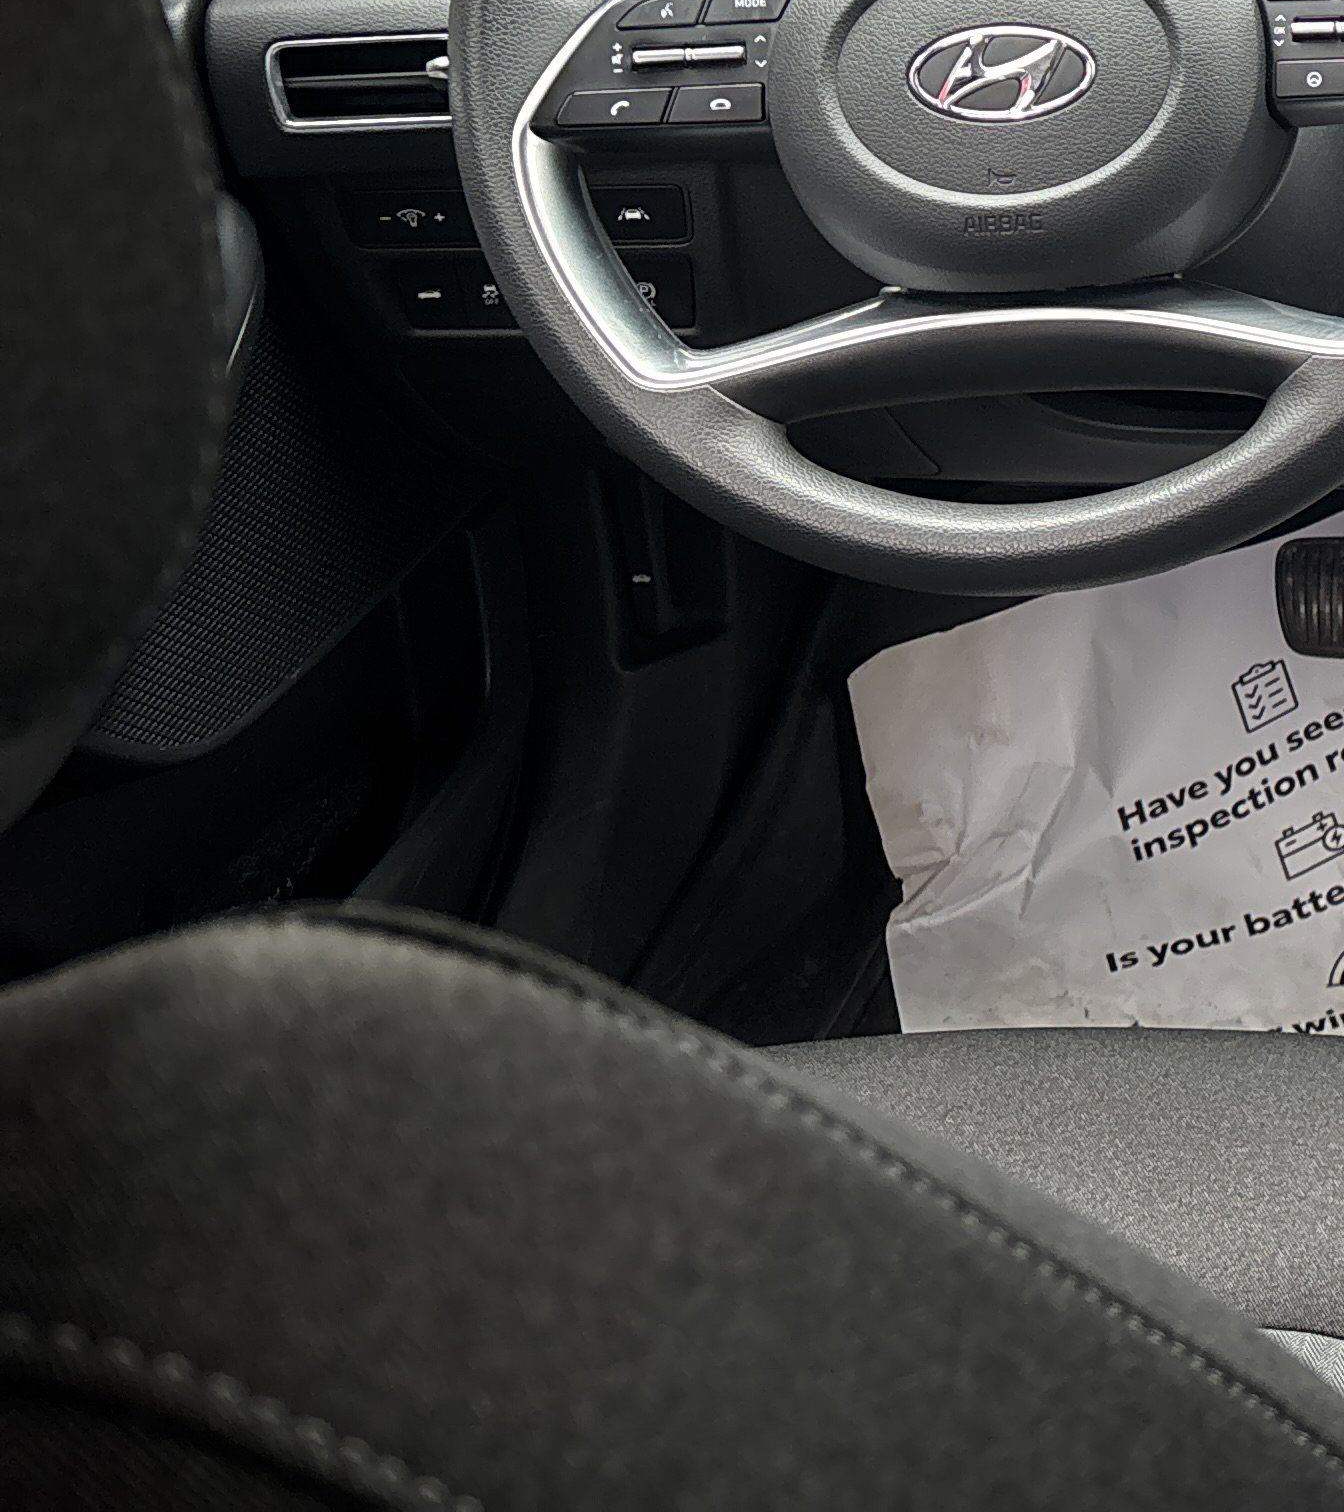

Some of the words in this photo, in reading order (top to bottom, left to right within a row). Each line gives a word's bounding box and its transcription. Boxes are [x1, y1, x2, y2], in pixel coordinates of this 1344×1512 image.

[1273, 26, 1286, 35] OK
[963, 213, 1043, 233] AIRBAG
[1116, 779, 1209, 831] Have
[1214, 741, 1281, 796] you
[1130, 761, 1322, 862] inspection
[1105, 949, 1139, 974] Is
[1146, 921, 1238, 970] your
